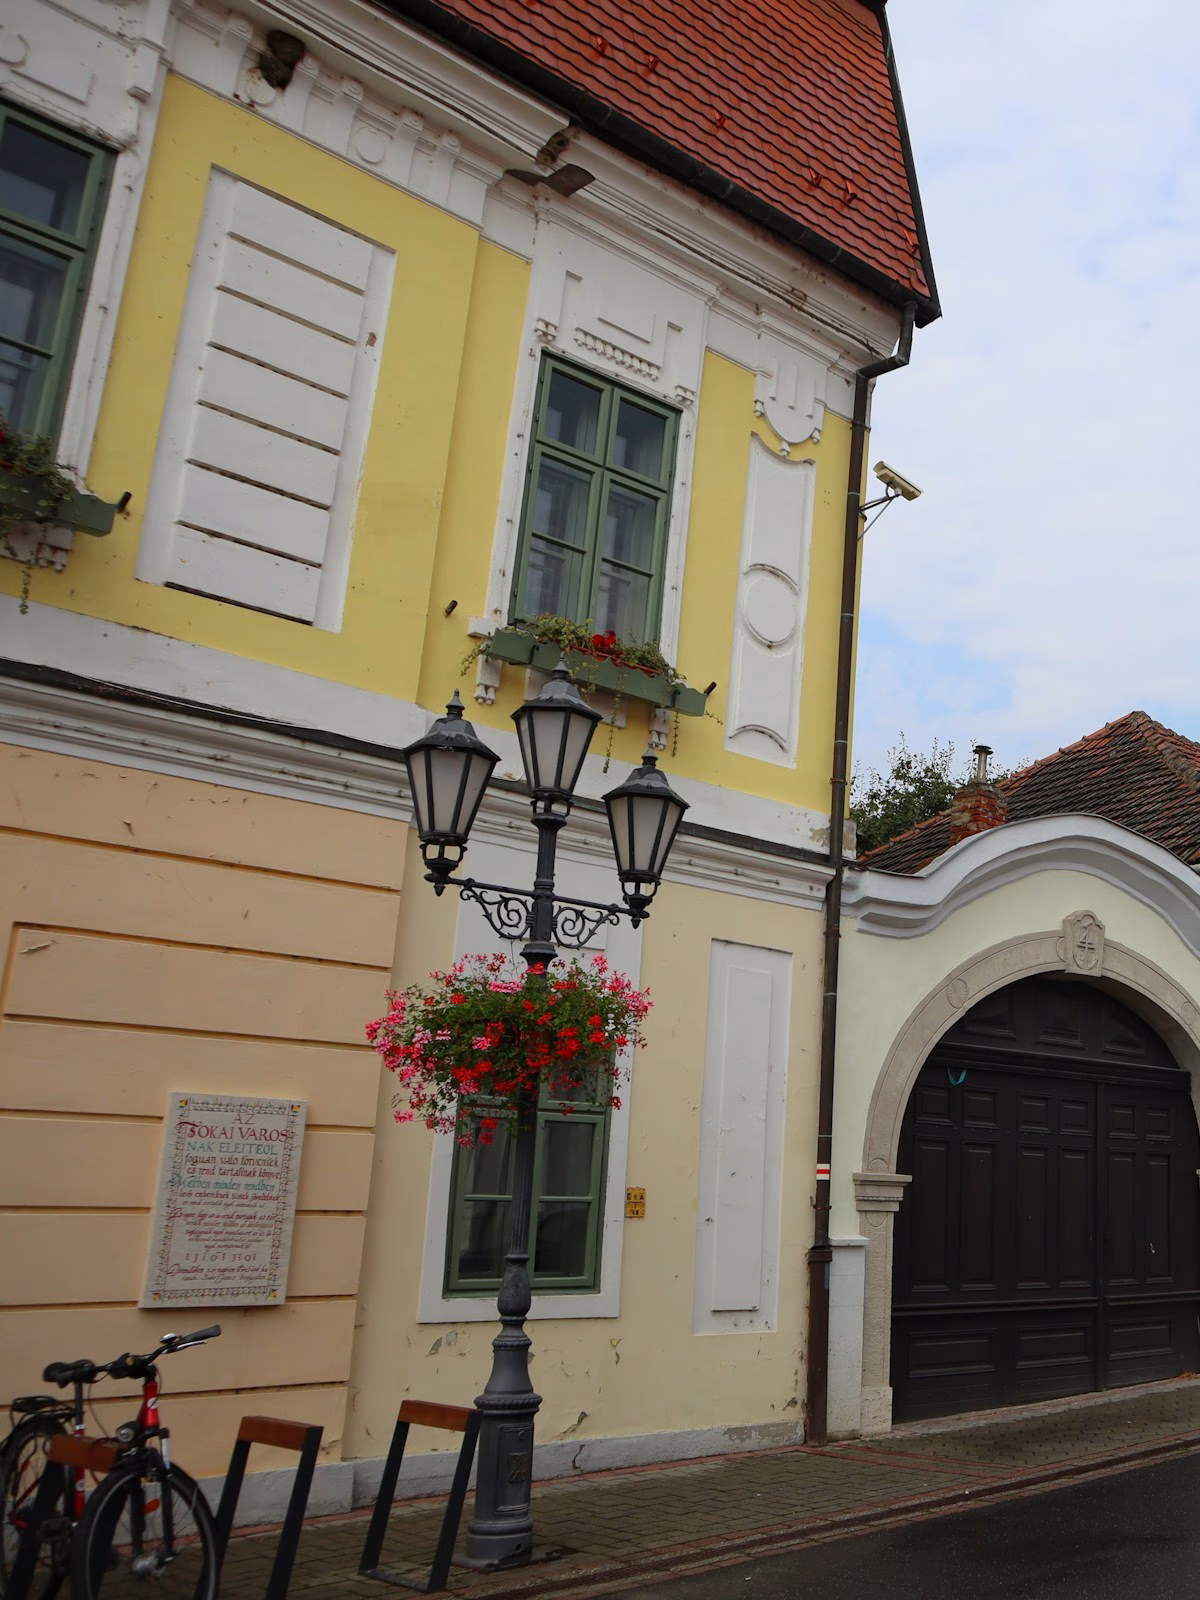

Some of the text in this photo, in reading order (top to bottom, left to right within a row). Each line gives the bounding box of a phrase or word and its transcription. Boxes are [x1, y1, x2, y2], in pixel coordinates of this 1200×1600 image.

[232, 1113, 256, 1125] AZ
[239, 1126, 289, 1142] VAROS
[186, 1141, 214, 1153] NAK
